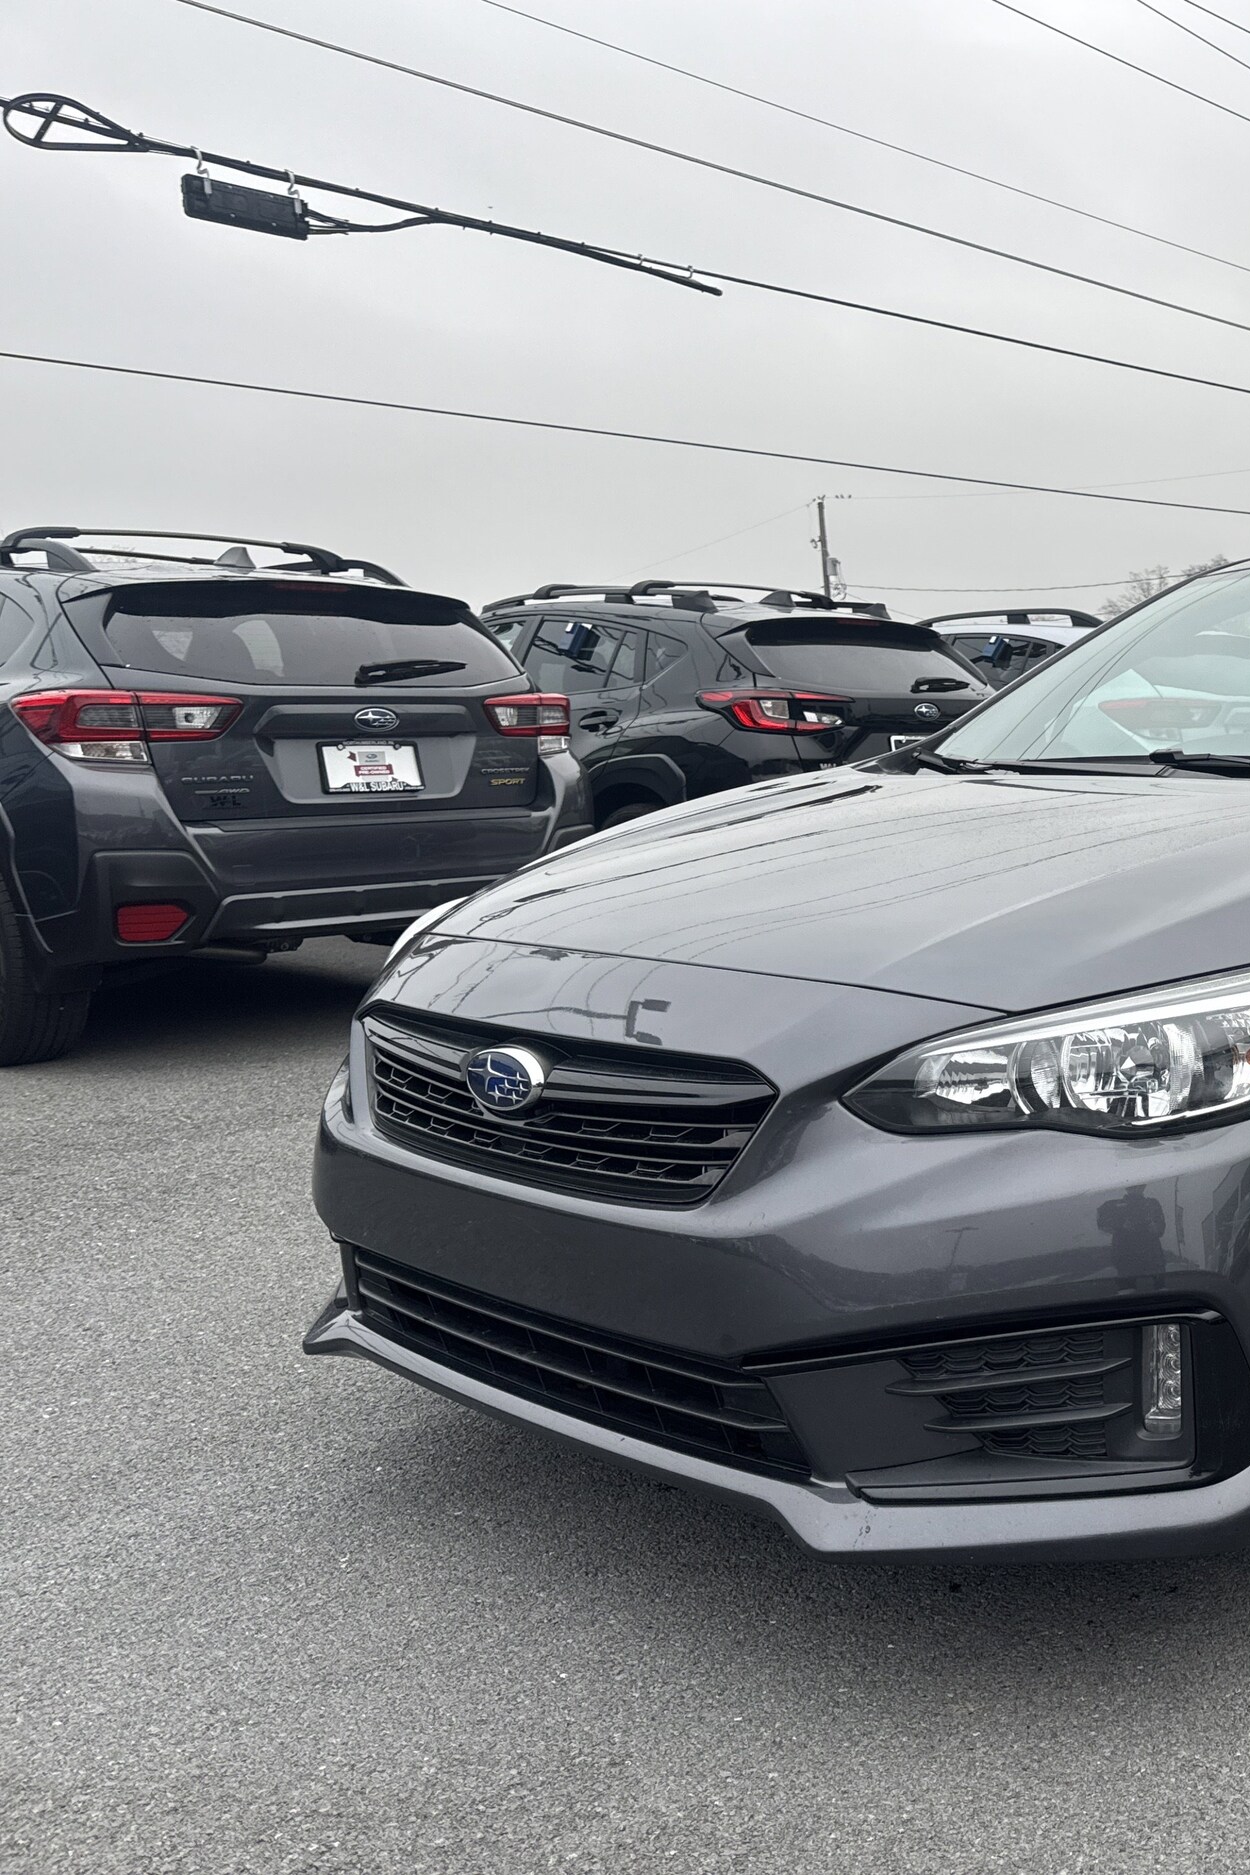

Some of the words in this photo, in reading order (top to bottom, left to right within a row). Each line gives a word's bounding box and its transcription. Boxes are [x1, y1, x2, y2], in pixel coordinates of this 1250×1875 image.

[181, 775, 254, 784] SUBARU
[490, 778, 526, 786] SPORT
[350, 782, 370, 792] W&L
[370, 781, 404, 792] SUBARU
